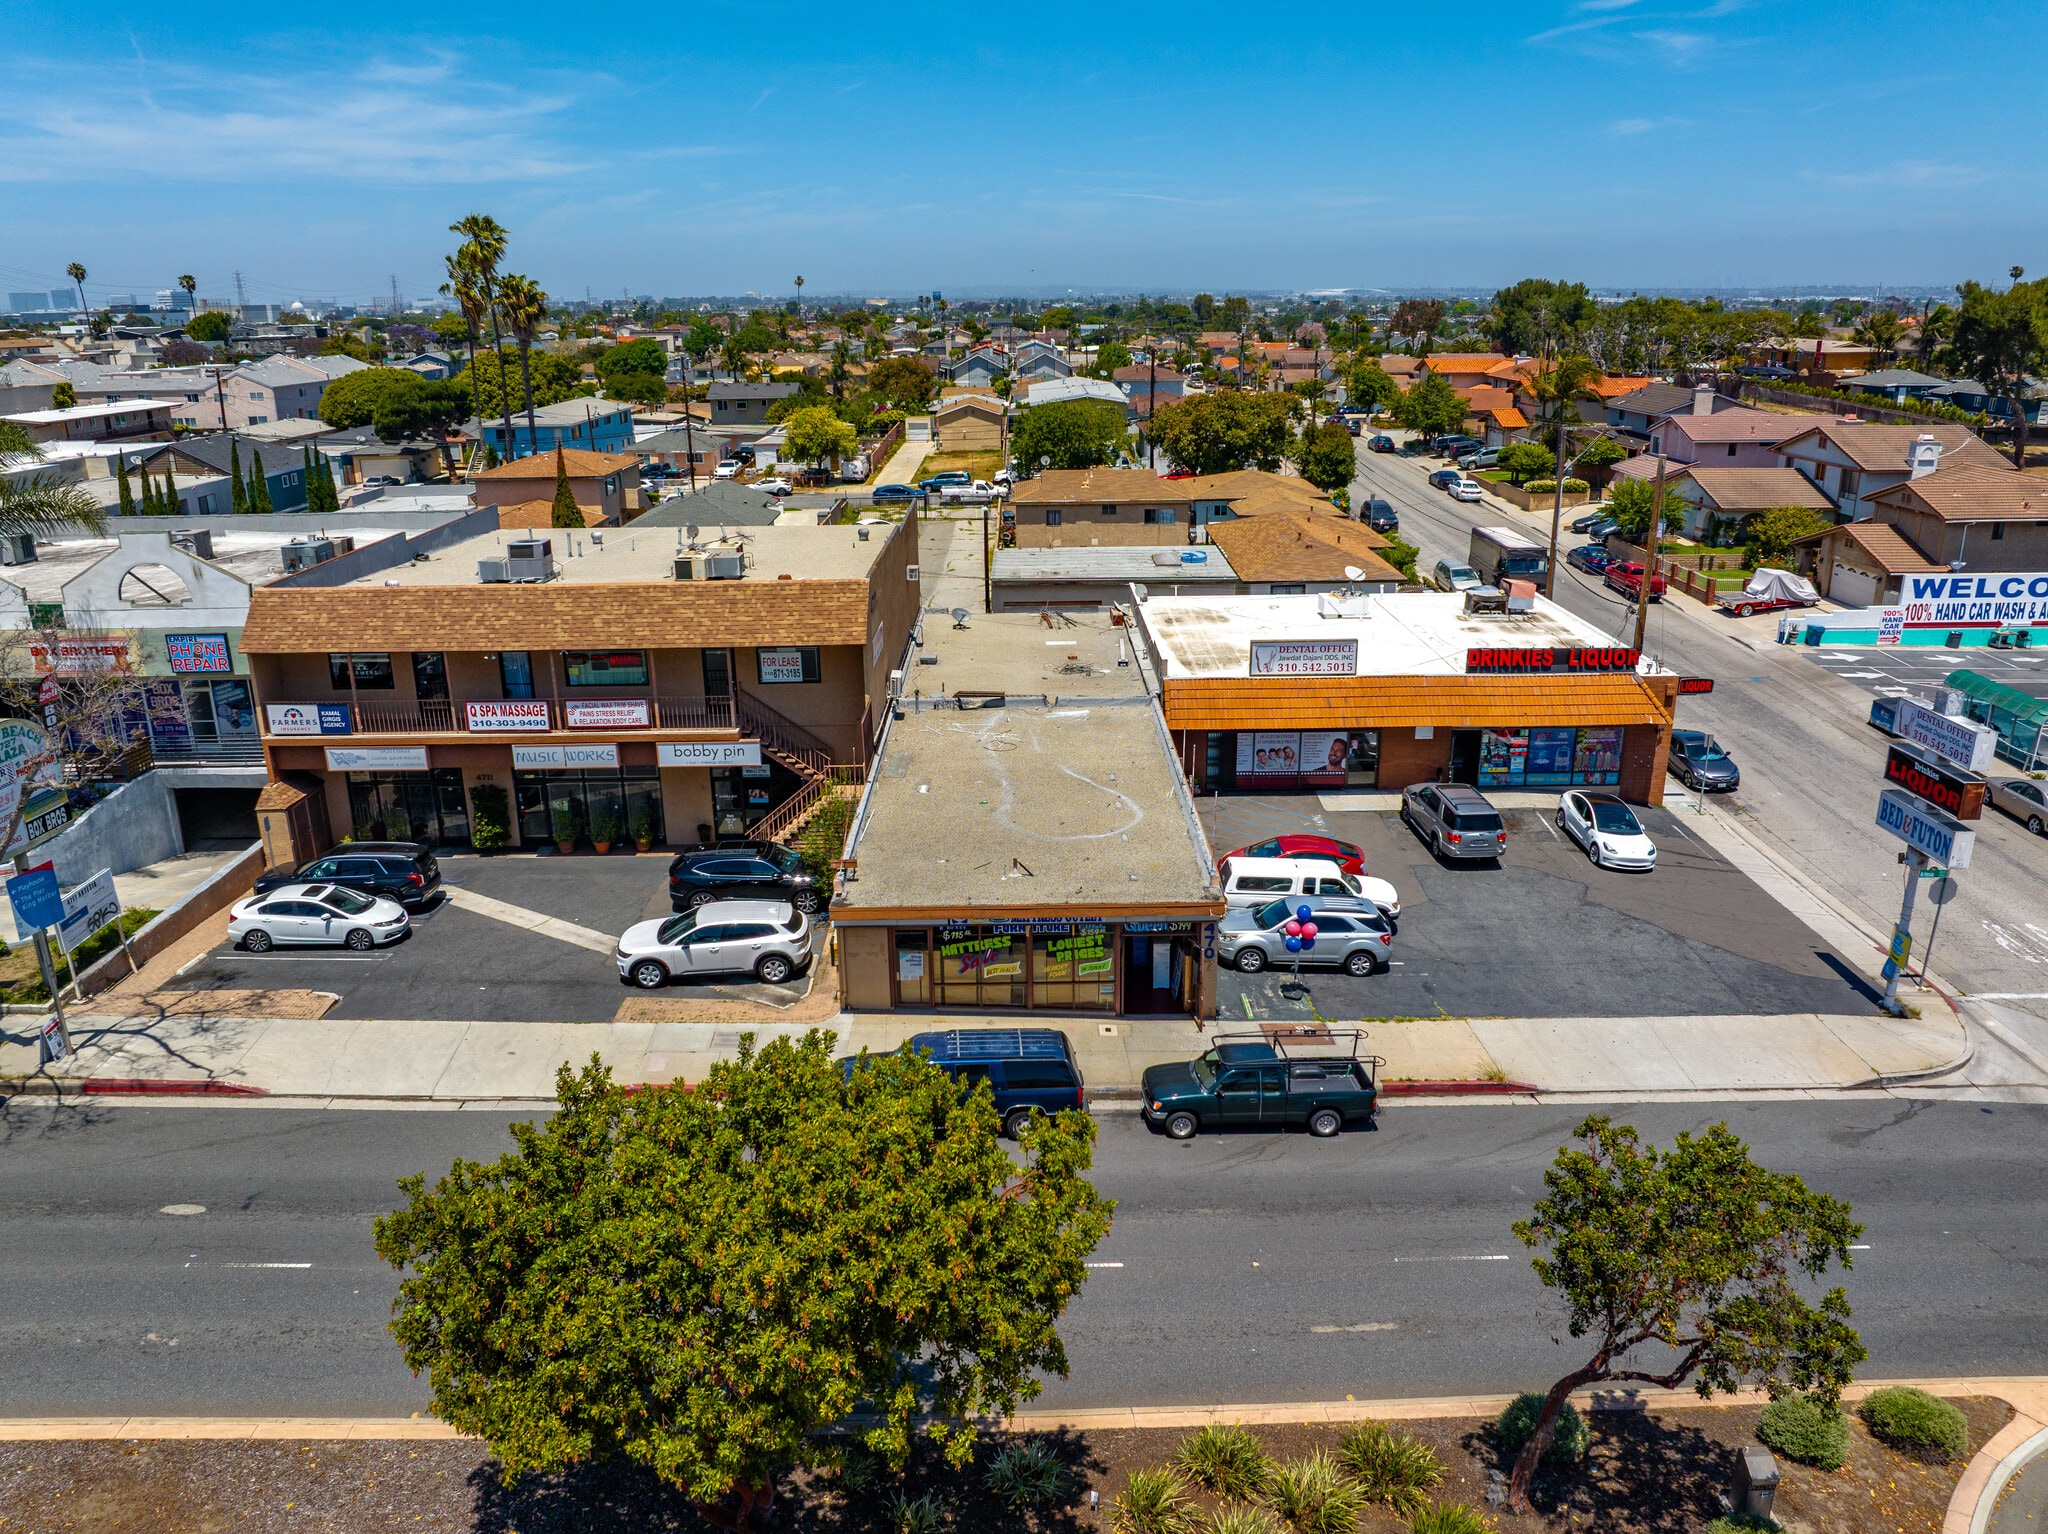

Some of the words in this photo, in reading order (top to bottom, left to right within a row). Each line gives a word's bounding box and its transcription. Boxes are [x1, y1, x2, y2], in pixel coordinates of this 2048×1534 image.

[1905, 603, 1932, 621] 100%
[1935, 602, 1966, 621] HAND
[1969, 602, 1991, 620] CAR
[1994, 602, 2026, 619] WASH
[2028, 602, 2036, 619] &
[169, 643, 228, 657] PHONE
[1279, 645, 1317, 654] DENTAL
[1319, 645, 1354, 653] OFFICE
[172, 657, 229, 671] REPAIR
[762, 657, 776, 667] FOR
[778, 657, 800, 667] LEASE
[1302, 654, 1323, 662] Dajani
[1468, 649, 1554, 667] DRINKIES
[1569, 649, 1640, 666] LIQUOR
[773, 668, 801, 679] 871-3185
[1277, 662, 1353, 672] 310.542.5015
[153, 683, 174, 695] BOX
[1680, 679, 1712, 692] LIQUOR
[40, 688, 58, 702] Sell
[470, 705, 477, 717] Q
[480, 704, 498, 717] SPA
[500, 704, 546, 717] MASSAGE
[617, 709, 635, 717] RELIEF
[472, 719, 546, 727] 310-303-9490
[1916, 710, 1946, 733] DENTAL
[1946, 723, 1975, 744] OFFICE
[673, 744, 719, 760] bobby
[723, 745, 745, 760] pin
[1912, 729, 1970, 765] 310.542.5015
[516, 751, 558, 763] MUSIC
[565, 750, 615, 761] WORKS
[1915, 762, 1940, 781] Drinkies
[1888, 759, 1960, 812] LIQUOR
[27, 817, 46, 840] BOX
[44, 806, 68, 830] BROS
[17, 876, 46, 893] Playhouse
[78, 880, 98, 899] ARTESIA
[20, 895, 32, 904] The
[33, 887, 46, 897] Pier
[21, 901, 37, 911] King
[37, 889, 57, 903] Harbor
[941, 935, 1012, 957] MATTRESS
[957, 946, 1000, 975] Sale
[1056, 946, 1105, 963] PRICES
[986, 968, 1000, 976] BEST
